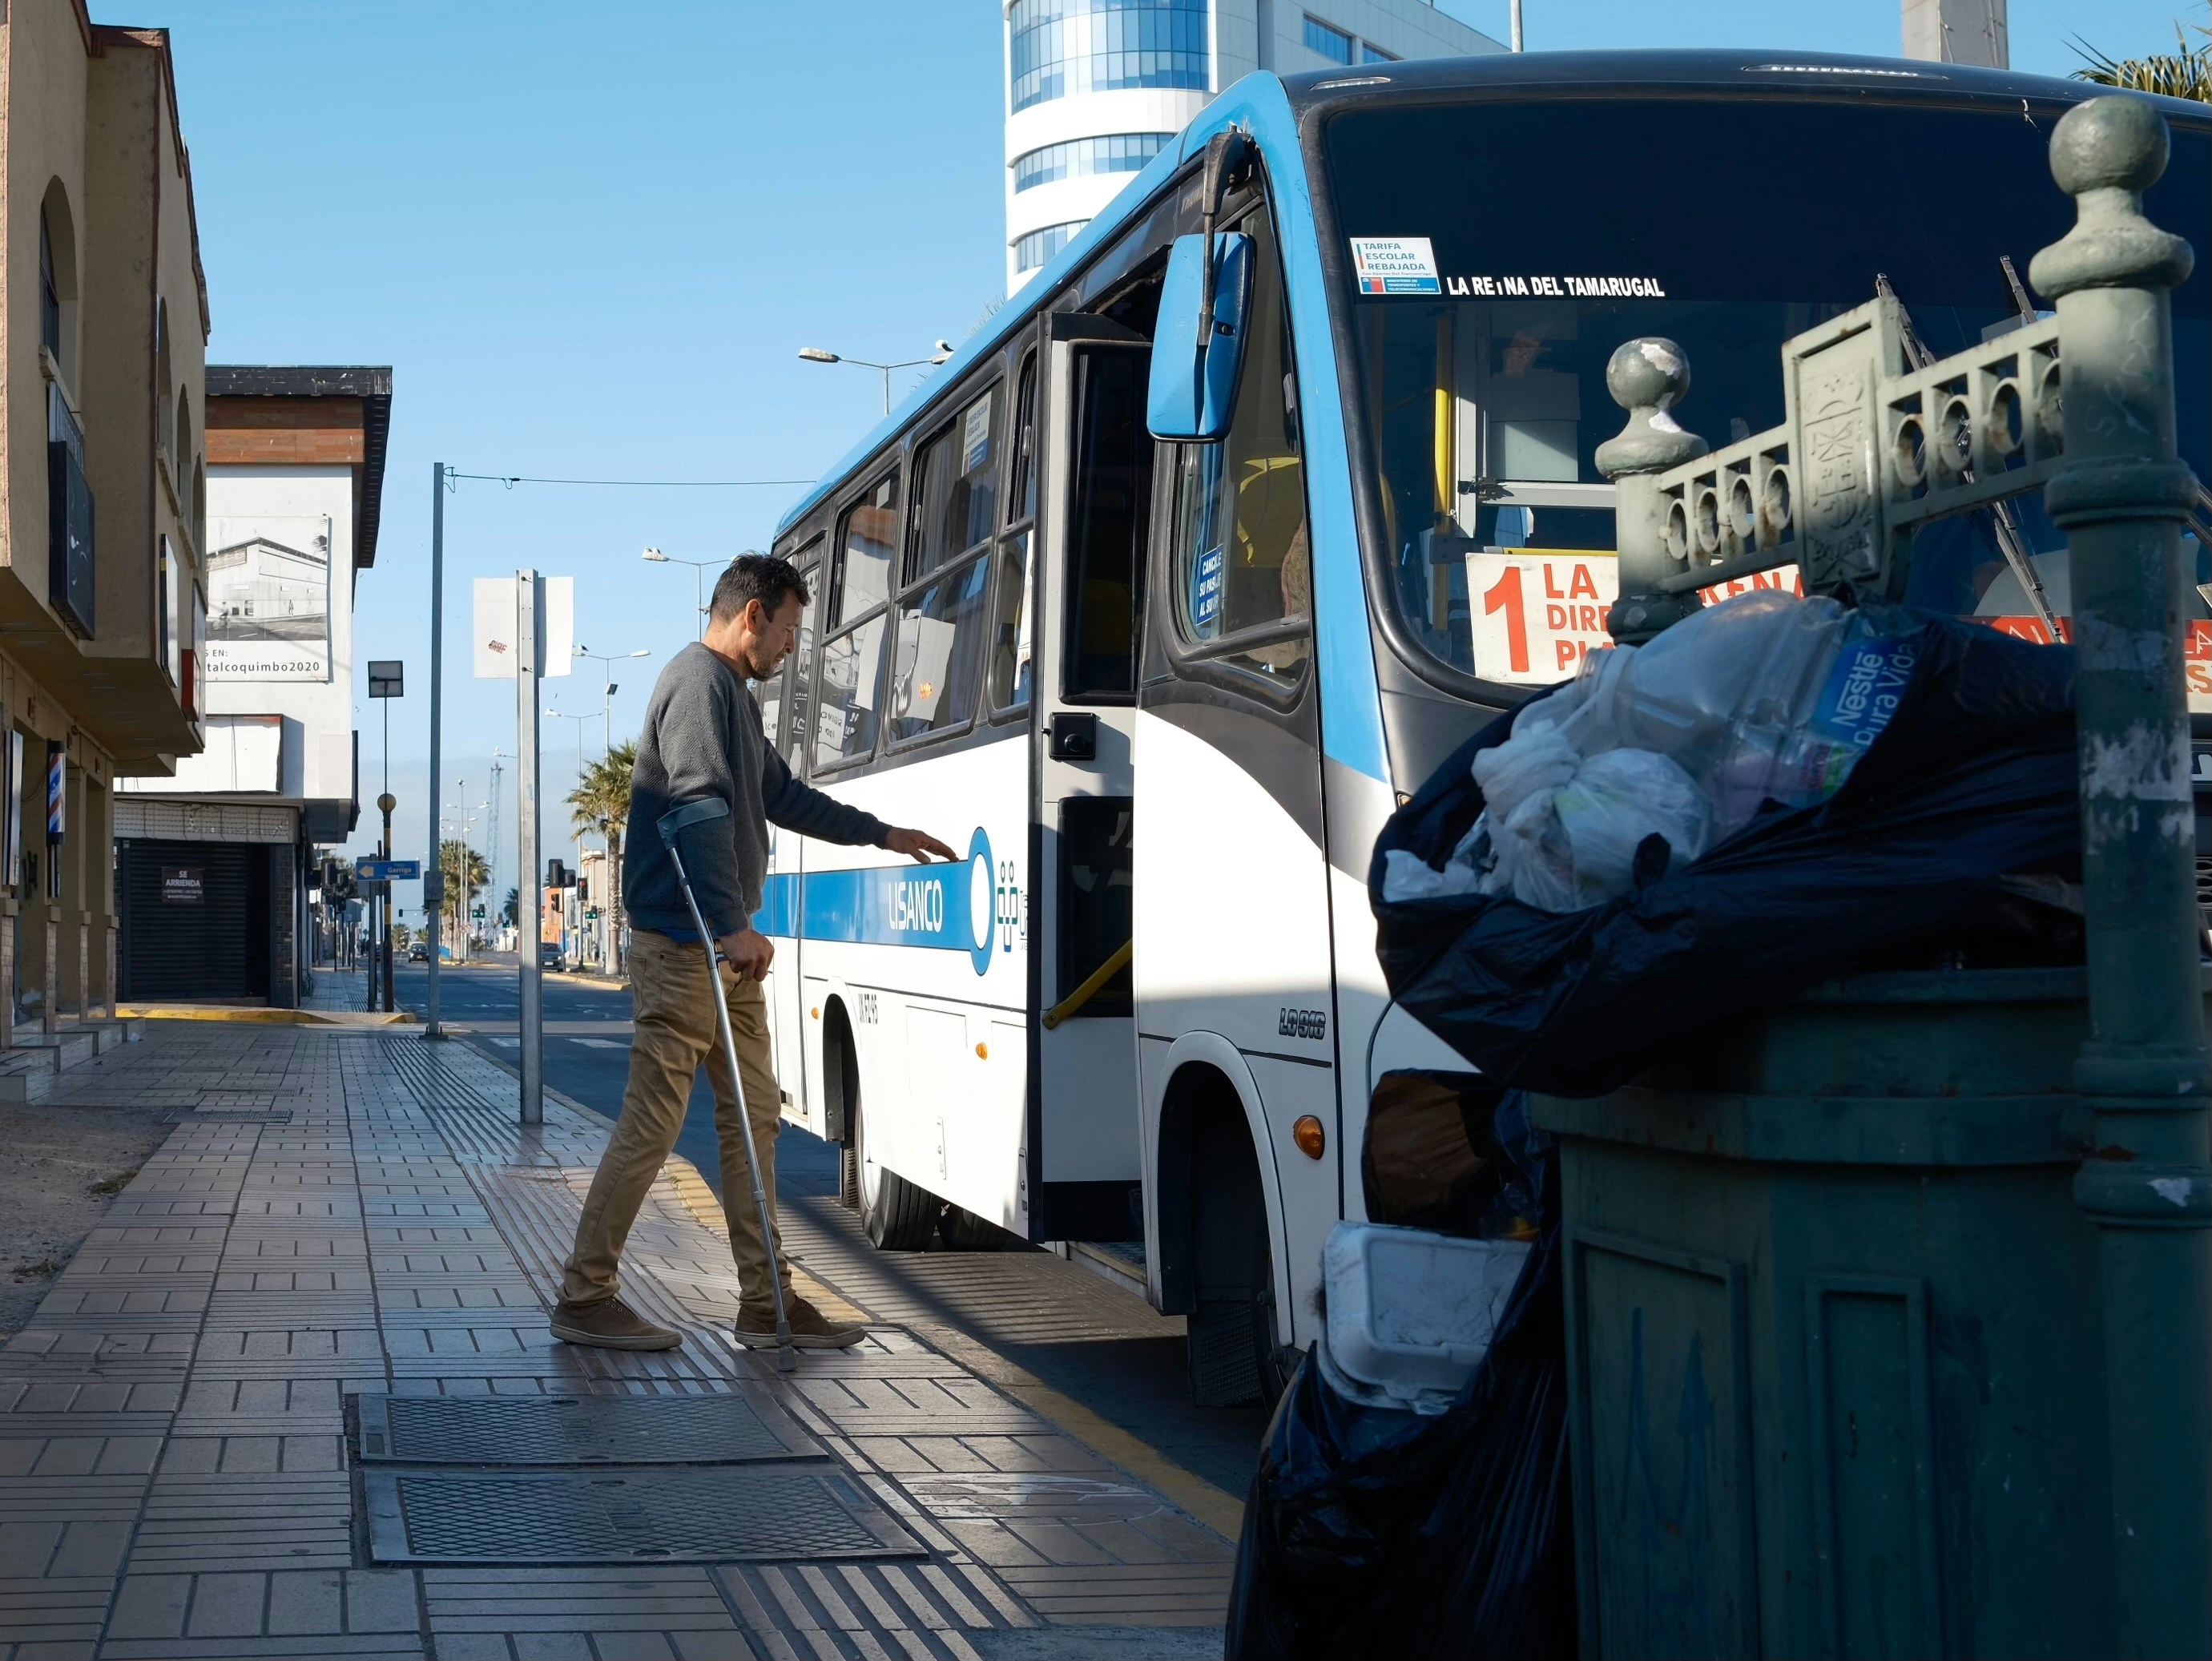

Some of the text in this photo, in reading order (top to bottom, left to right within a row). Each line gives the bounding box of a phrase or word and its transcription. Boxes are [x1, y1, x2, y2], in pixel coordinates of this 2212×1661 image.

[1446, 276, 1470, 296] LA
[1530, 277, 1563, 296] DEL
[1564, 277, 1666, 297] TAMARUGAL
[1543, 563, 1599, 599] LA
[1199, 602, 1206, 618] AL
[1484, 566, 1529, 673] 1
[212, 649, 228, 657] EN:
[207, 661, 320, 674] talcoquimbo2020
[1853, 643, 1918, 745] Pura Vida
[166, 878, 200, 887] ARRIENDA
[179, 870, 187, 878] SE
[888, 879, 943, 933] LISANCO
[1298, 1010, 1326, 1040] 916
